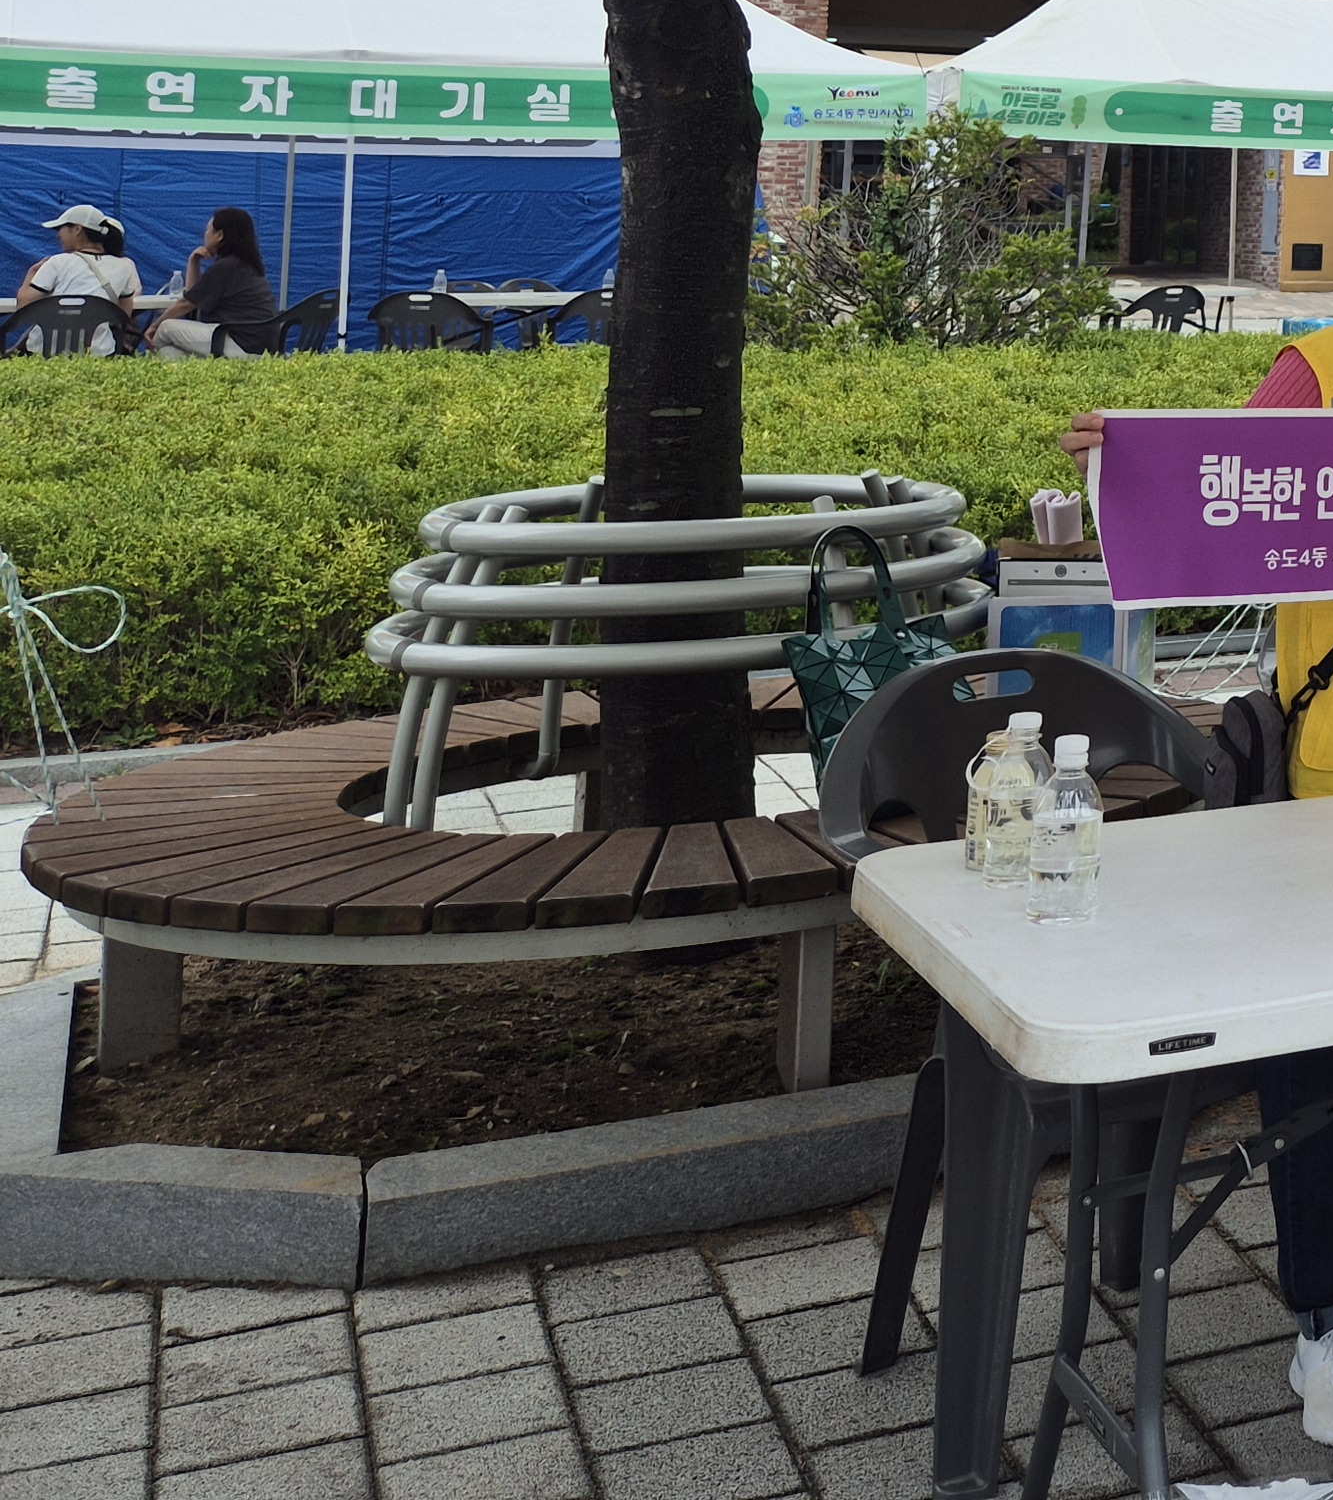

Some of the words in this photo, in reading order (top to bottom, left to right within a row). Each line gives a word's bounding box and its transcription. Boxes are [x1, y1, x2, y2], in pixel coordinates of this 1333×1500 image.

[827, 86, 879, 101] Yeonsu
[1199, 454, 1306, 527] 행복한
[1263, 546, 1328, 570] 송도4동
[1158, 1036, 1207, 1051] LIFETIME
